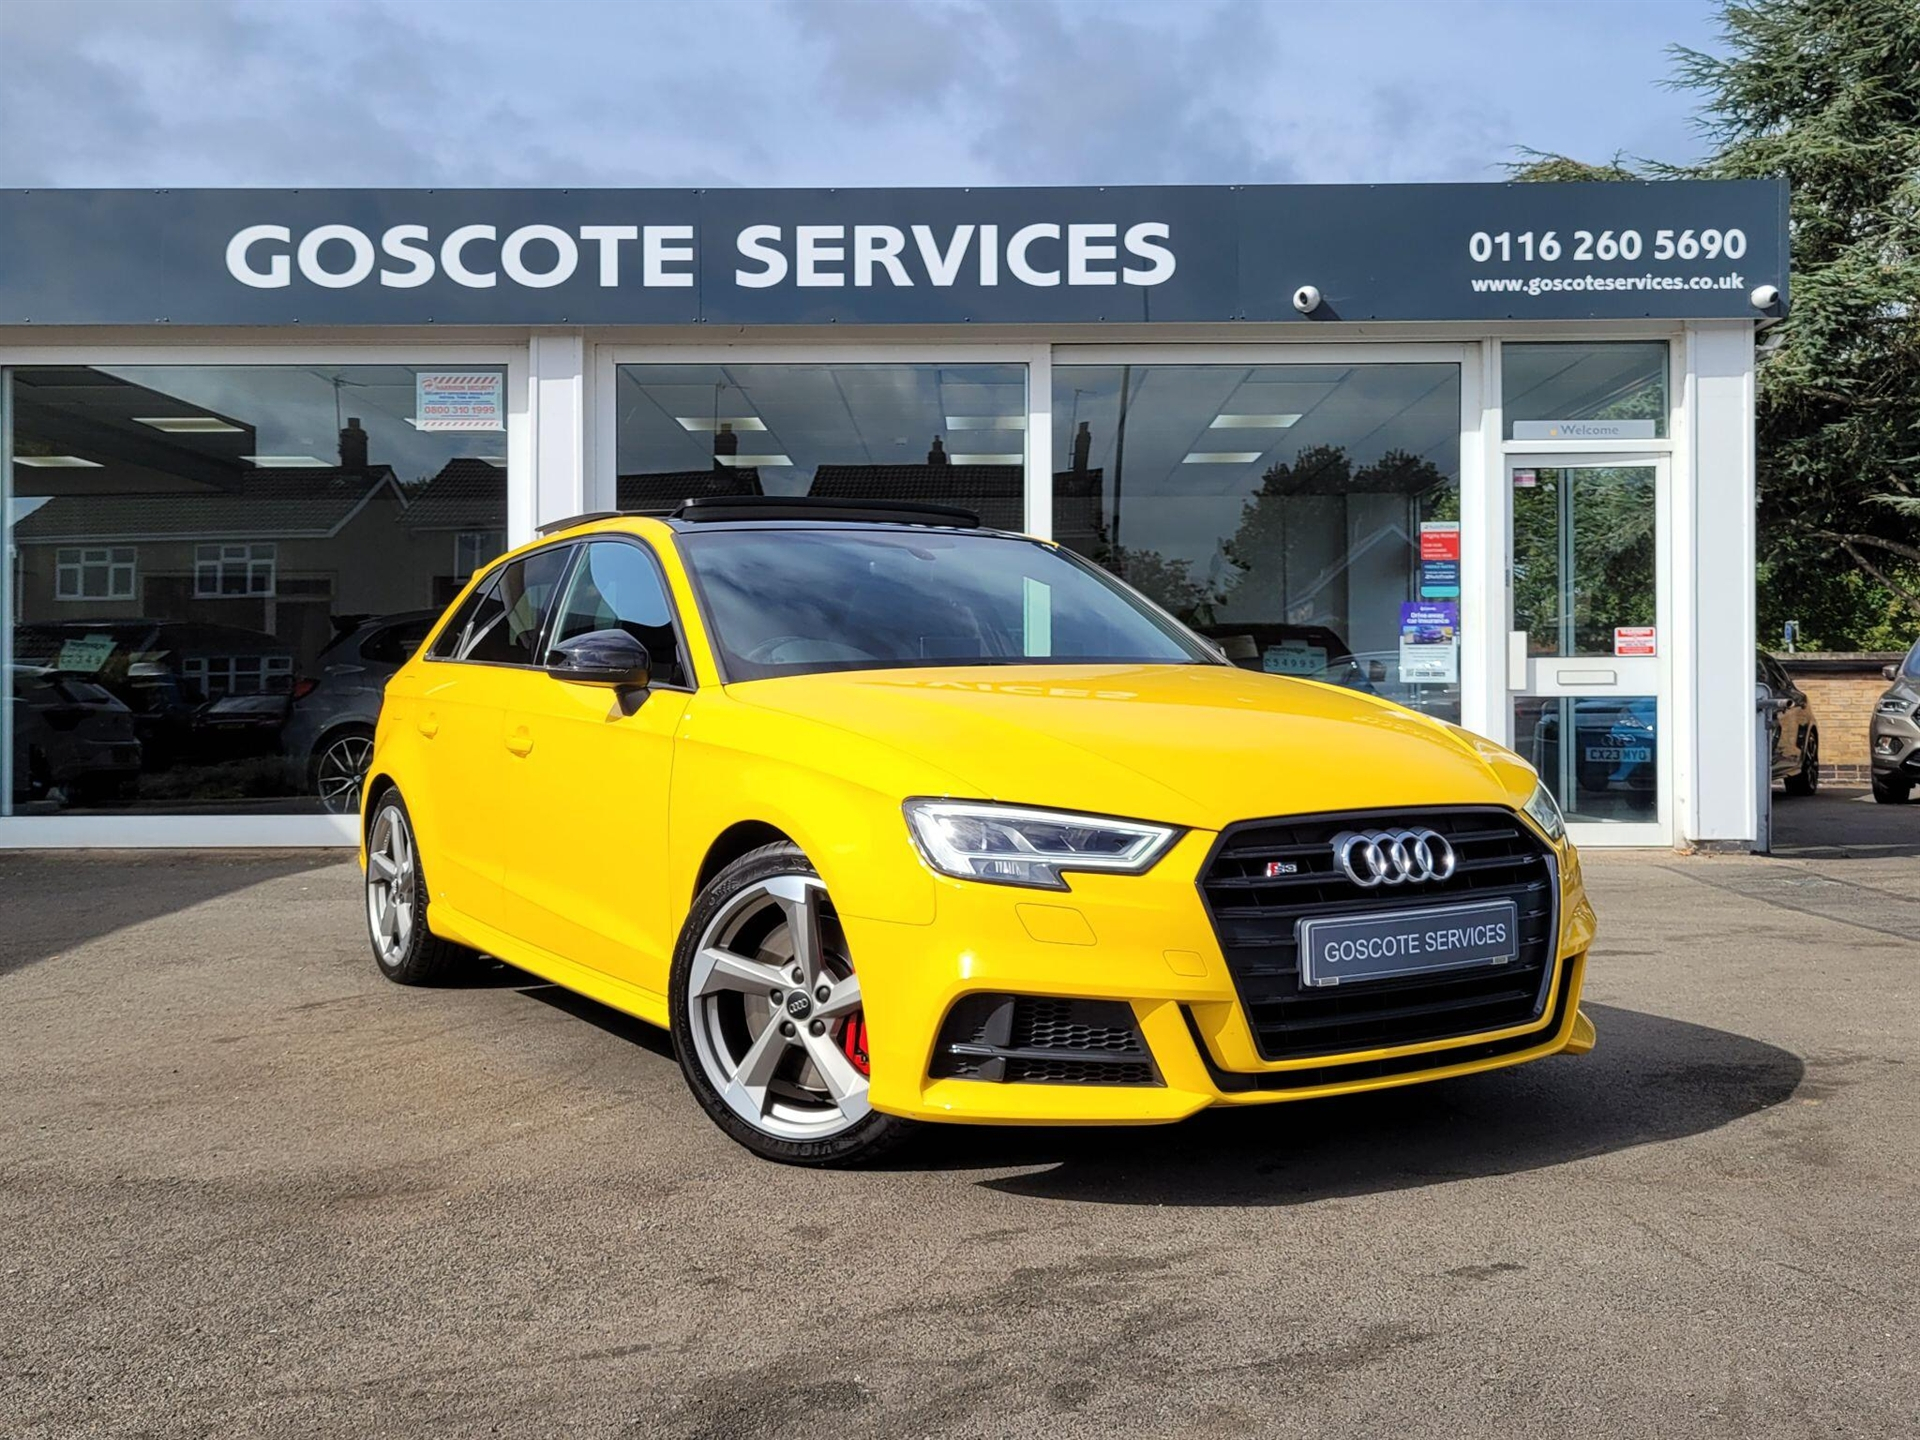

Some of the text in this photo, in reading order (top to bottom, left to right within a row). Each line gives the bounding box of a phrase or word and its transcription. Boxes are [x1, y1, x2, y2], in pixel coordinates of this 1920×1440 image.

[225, 222, 1177, 289] GOSCOTE SERVICES
[1469, 229, 1748, 262] 0116 260 5690
[1471, 272, 1745, 295] www.goscoteservices.co.uk
[424, 406, 495, 414] 0800 310 1999
[1560, 424, 1619, 435] Welcome
[1590, 749, 1620, 760] CX23
[1324, 923, 1506, 962] GOSCOTE SERVICES
